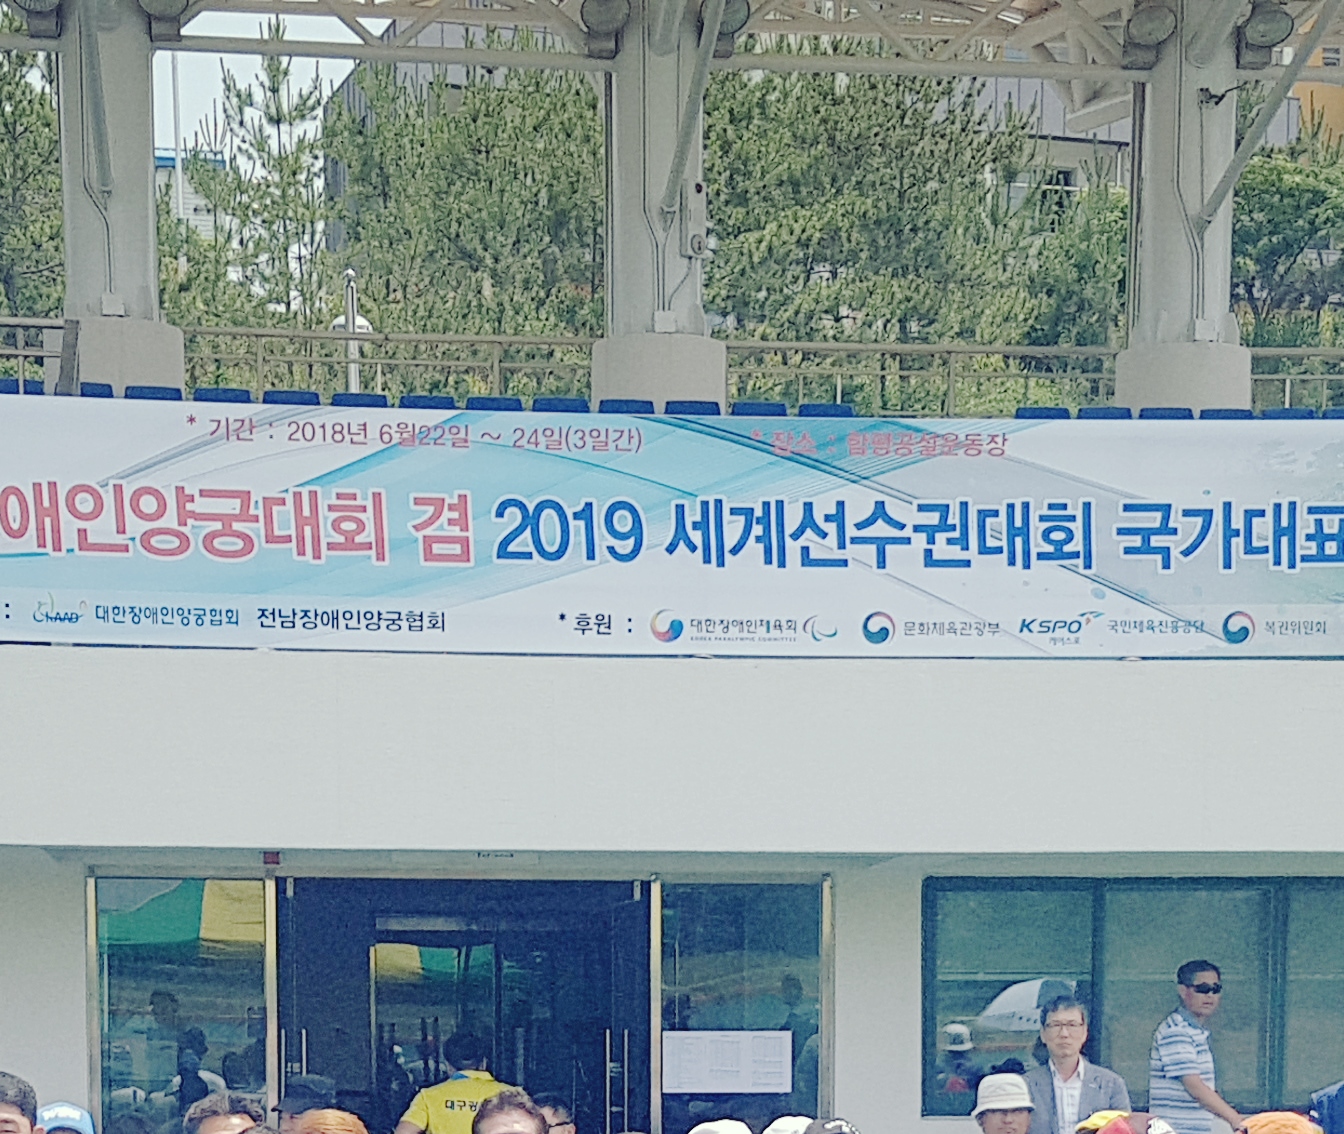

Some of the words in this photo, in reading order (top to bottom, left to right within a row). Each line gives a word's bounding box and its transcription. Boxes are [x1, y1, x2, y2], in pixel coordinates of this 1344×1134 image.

[209, 418, 257, 442] 기간
[287, 421, 368, 445] 2018년
[379, 424, 471, 449] 6월22일
[512, 427, 643, 453] 24일(3일간)
[771, 431, 817, 457] 장소
[847, 431, 1009, 457] 함평공설운동장
[412, 492, 475, 565] 겸
[494, 498, 645, 563] 2019
[665, 498, 1093, 570] 세계선수권대회
[96, 604, 240, 627] 대한장애인양궁협회
[257, 607, 446, 632] 전남장애인양궁협회
[573, 613, 612, 635] 후원
[690, 618, 797, 634] 대한장애인체육회
[1019, 618, 1082, 634] KSPO
[1107, 619, 1205, 634] 국민체육진흥공단
[1264, 620, 1327, 635] 복권위원회
[904, 621, 1000, 637] 문화체육관광부
